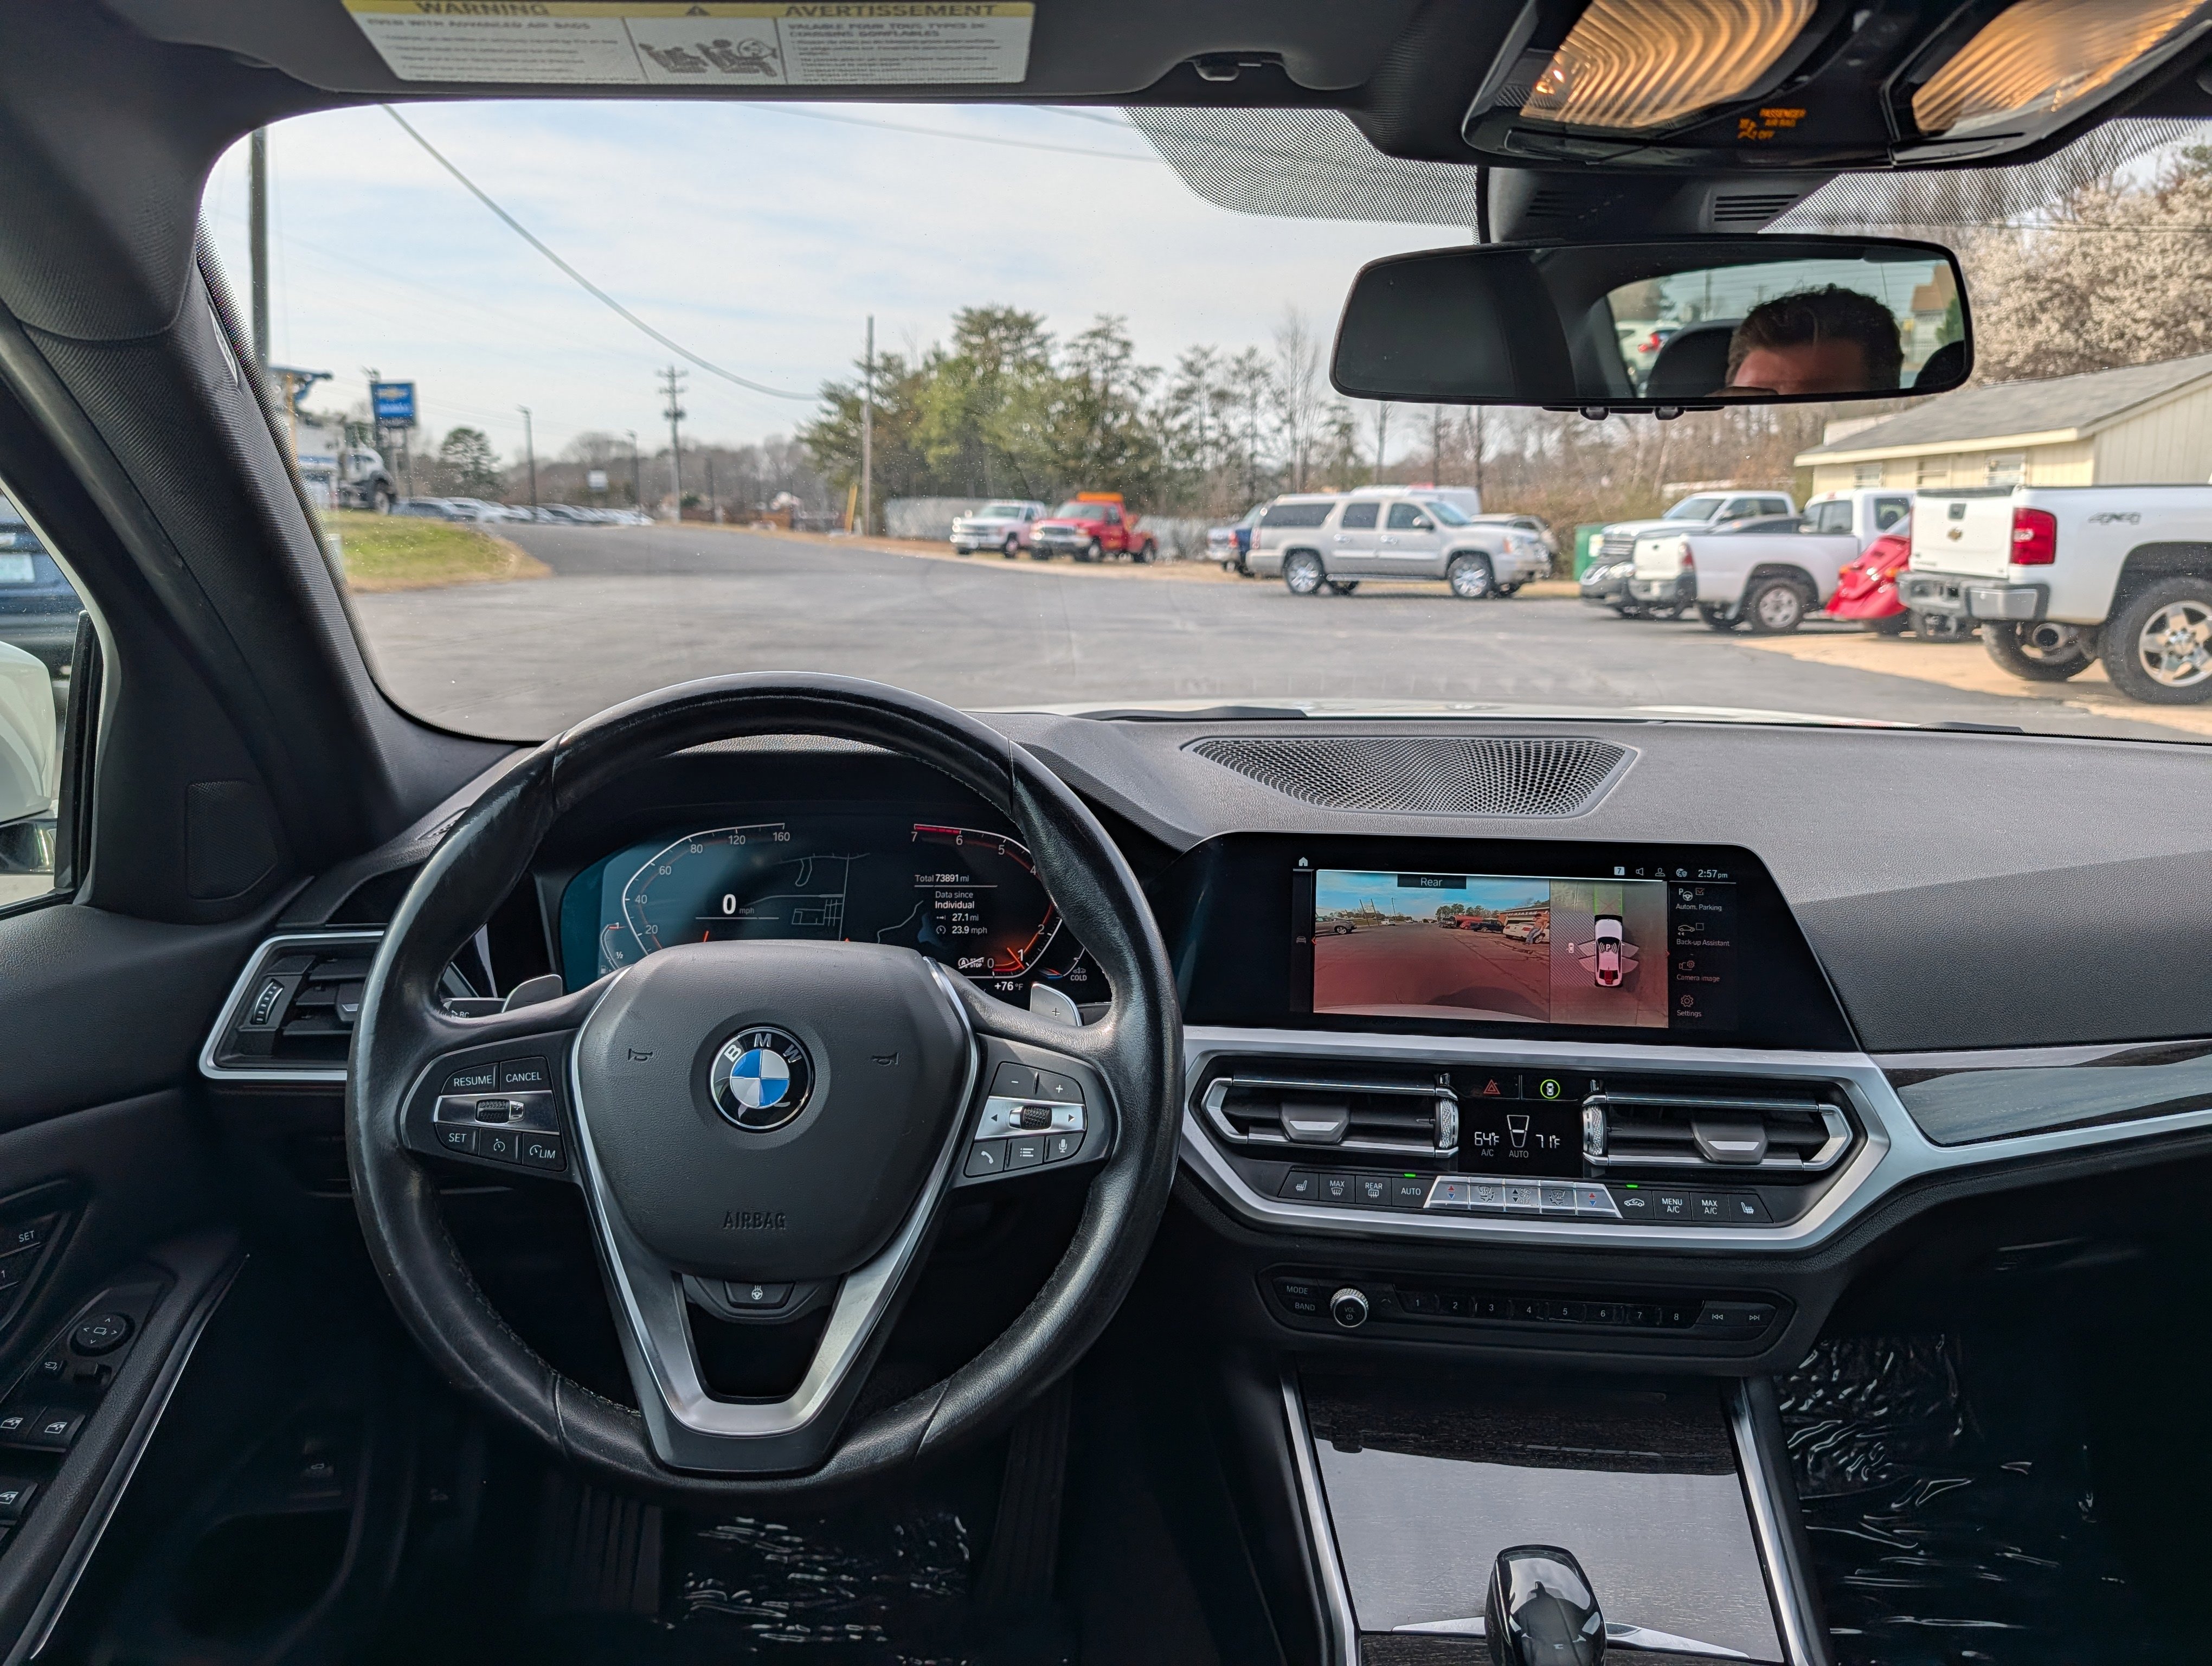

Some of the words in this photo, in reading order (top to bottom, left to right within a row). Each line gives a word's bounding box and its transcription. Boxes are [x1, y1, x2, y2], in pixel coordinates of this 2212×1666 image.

[415, 1, 550, 16] WARNING
[785, 4, 995, 17] AVERTISSEMENT
[728, 835, 746, 845] 120
[773, 831, 790, 842] 160
[911, 831, 918, 842] 7
[956, 835, 963, 846] 6
[690, 844, 703, 854] 80
[998, 844, 1005, 855] 5
[659, 866, 672, 876] 60
[1030, 864, 1037, 875] 4
[1697, 869, 1717, 877] 2:57
[915, 874, 935, 882] Total
[935, 874, 959, 882] 73891
[960, 874, 970, 882] mi
[1420, 877, 1443, 887] Rear
[635, 894, 647, 904] 40
[935, 890, 953, 899] Data
[954, 890, 974, 899] since
[723, 893, 737, 915] 0
[739, 907, 755, 916] mph
[935, 900, 975, 909] Individual
[1699, 904, 1722, 912] Parking
[952, 913, 969, 922] 27.1
[970, 913, 979, 922] mi
[645, 924, 658, 934] 20
[952, 925, 969, 934] 23.9
[971, 926, 987, 936] mph
[1037, 924, 1045, 935] 2
[1018, 949, 1024, 962] 1
[987, 958, 994, 969] 0
[994, 981, 1013, 991] +76
[724, 1033, 802, 1063] BMW
[454, 1075, 492, 1087] RESUME
[506, 1072, 542, 1082] CANCEL
[448, 1133, 467, 1143] SET
[539, 1150, 556, 1159] LIM
[1481, 1149, 1494, 1157] A/C
[1509, 1150, 1529, 1158] AUTO
[1365, 1182, 1383, 1190] REAR
[1401, 1187, 1422, 1196] AUTO
[1662, 1197, 1683, 1206] MENU
[1701, 1199, 1718, 1207] MAX
[1667, 1205, 1680, 1214] A/C
[1704, 1207, 1718, 1215] A/C
[723, 1211, 786, 1230] AIRBAG
[19, 1230, 34, 1242] SET
[1, 1270, 5, 1278] 1
[1287, 1285, 1308, 1295] MODE
[1295, 1302, 1315, 1311] BAND
[1452, 1302, 1458, 1310] 2
[1489, 1303, 1494, 1311] 3
[1637, 1311, 1642, 1319] 7
[1674, 1313, 1679, 1321] 8
